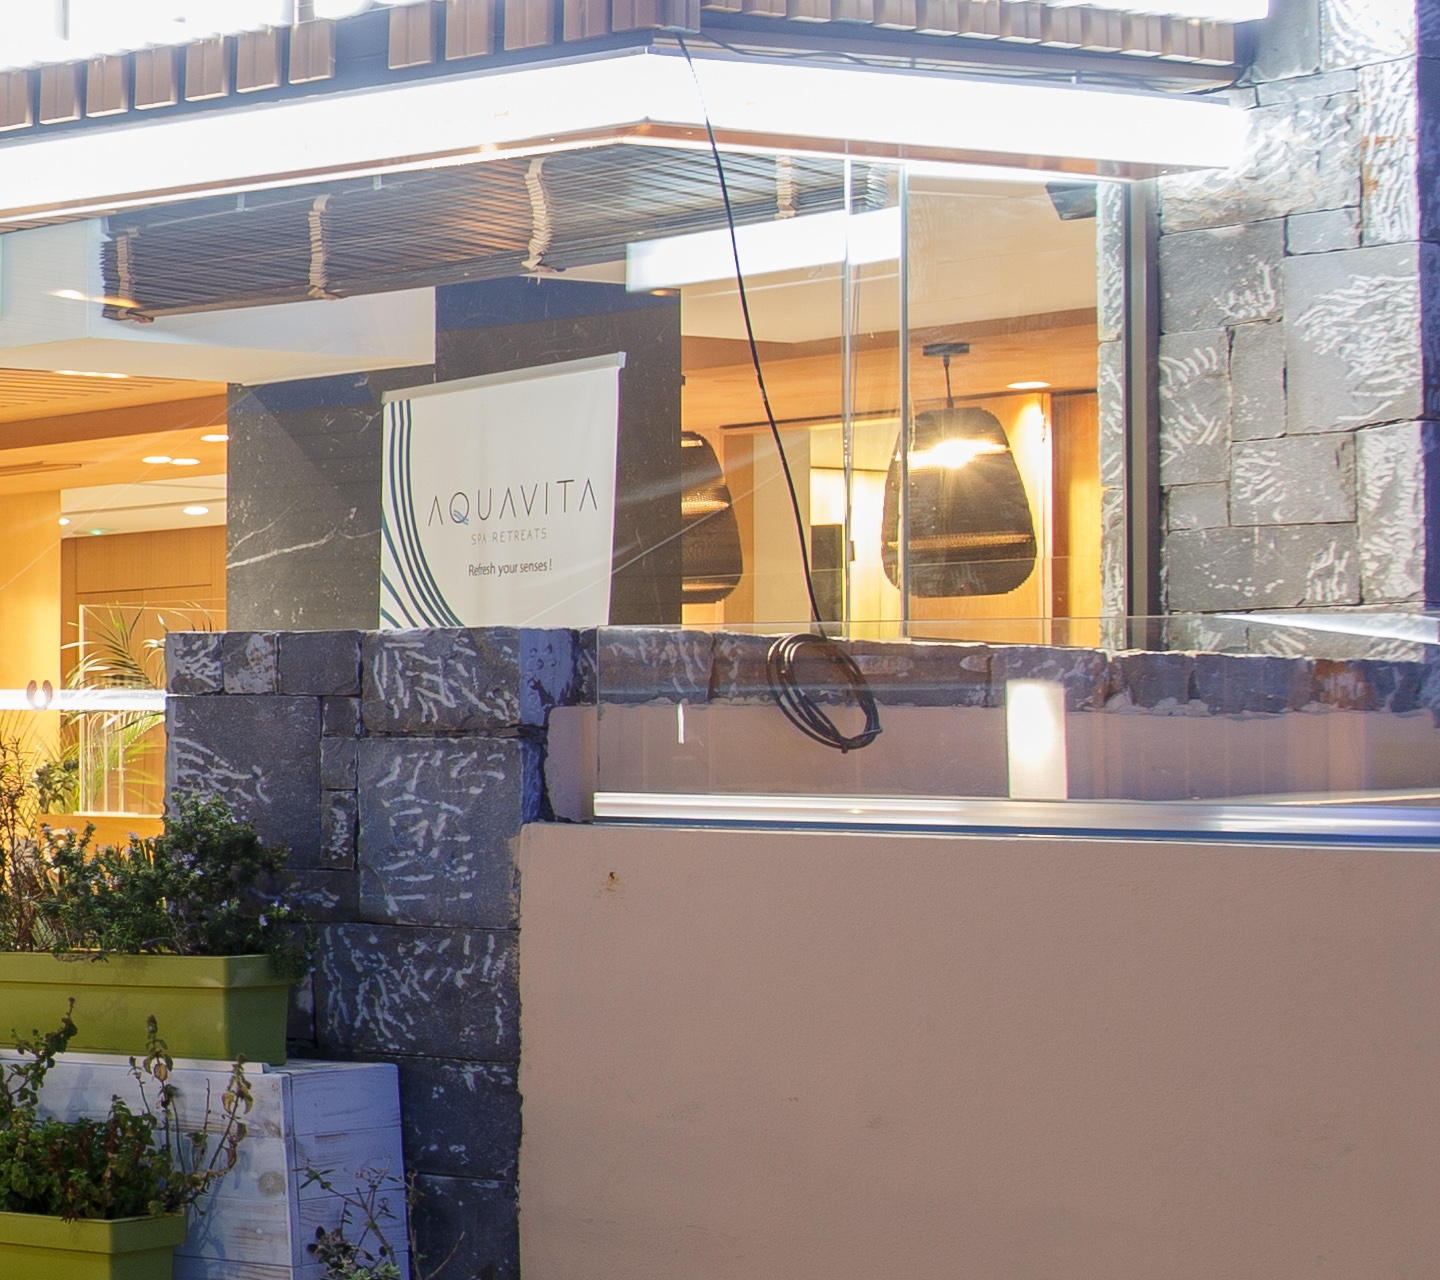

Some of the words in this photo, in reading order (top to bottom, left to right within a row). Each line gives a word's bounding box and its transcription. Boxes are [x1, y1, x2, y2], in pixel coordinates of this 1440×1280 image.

[427, 477, 598, 527] AQUAVITA
[471, 533, 487, 545] SPA
[492, 527, 548, 543] RETREATS
[468, 562, 496, 577] Refresh
[498, 563, 518, 577] your
